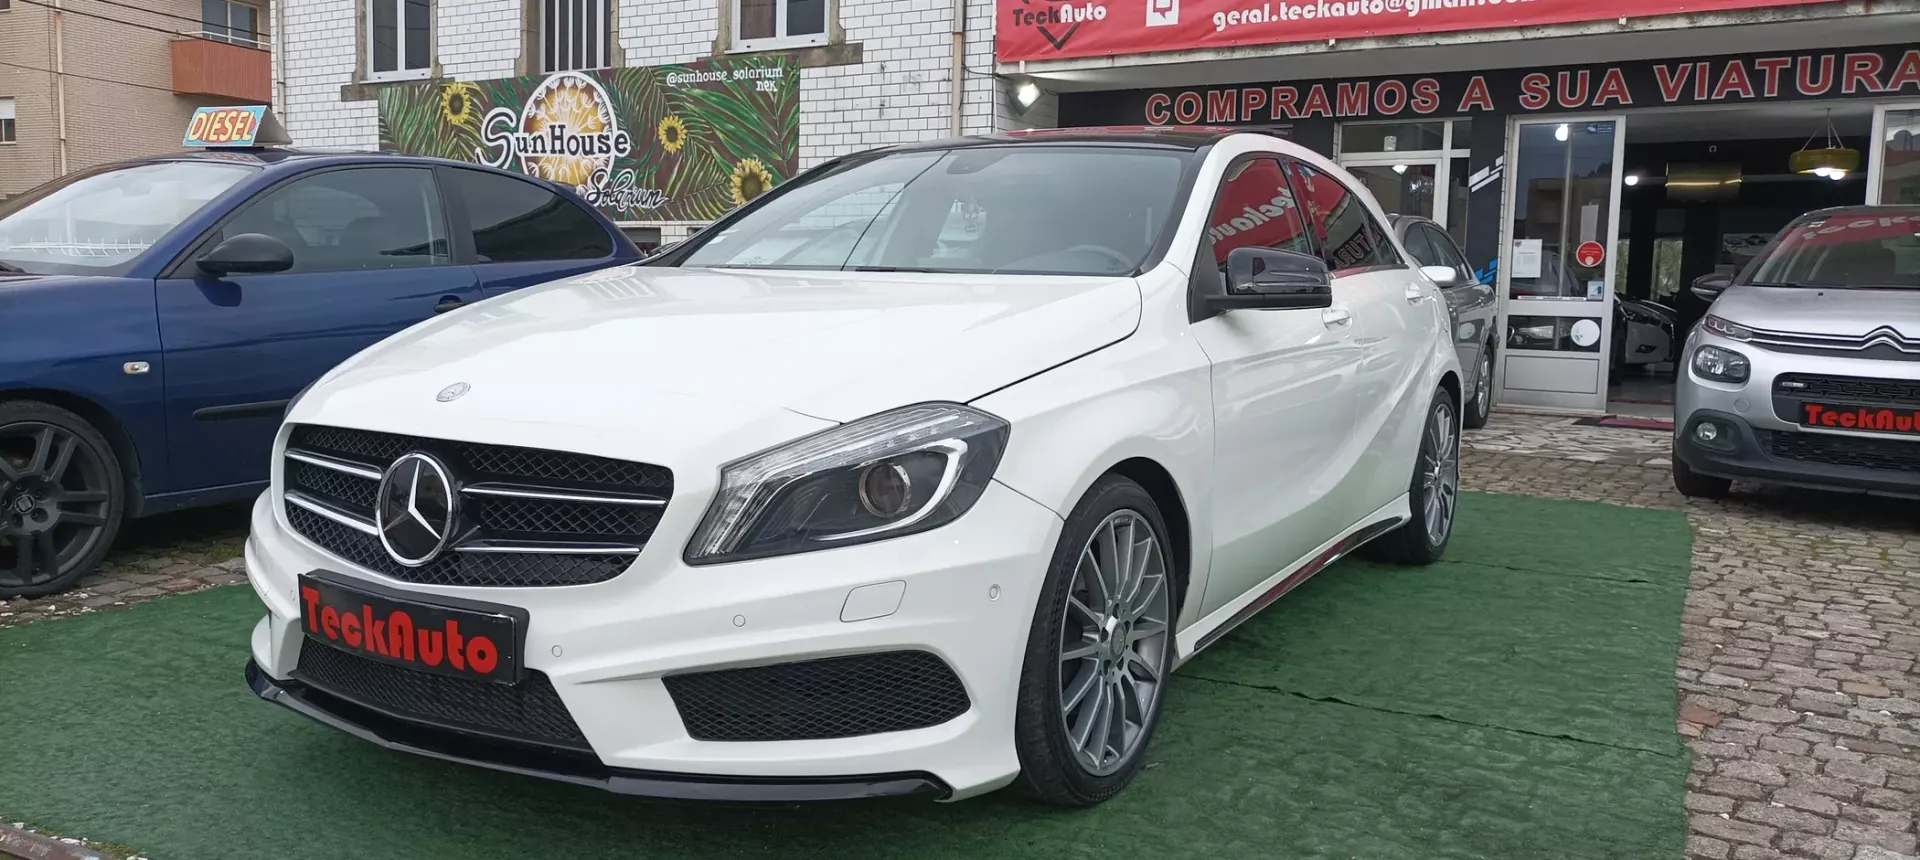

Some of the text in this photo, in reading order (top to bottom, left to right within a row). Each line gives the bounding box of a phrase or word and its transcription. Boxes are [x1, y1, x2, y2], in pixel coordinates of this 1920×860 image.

[1012, 3, 1107, 27] TeckAuto
[666, 65, 783, 87] @sunhouse_solarium
[1145, 49, 1920, 125] COMPRAMOS A SUA VIATURA
[188, 110, 255, 142] DIESEL
[586, 168, 669, 212] Solarium
[302, 585, 499, 674] TeckAuto
